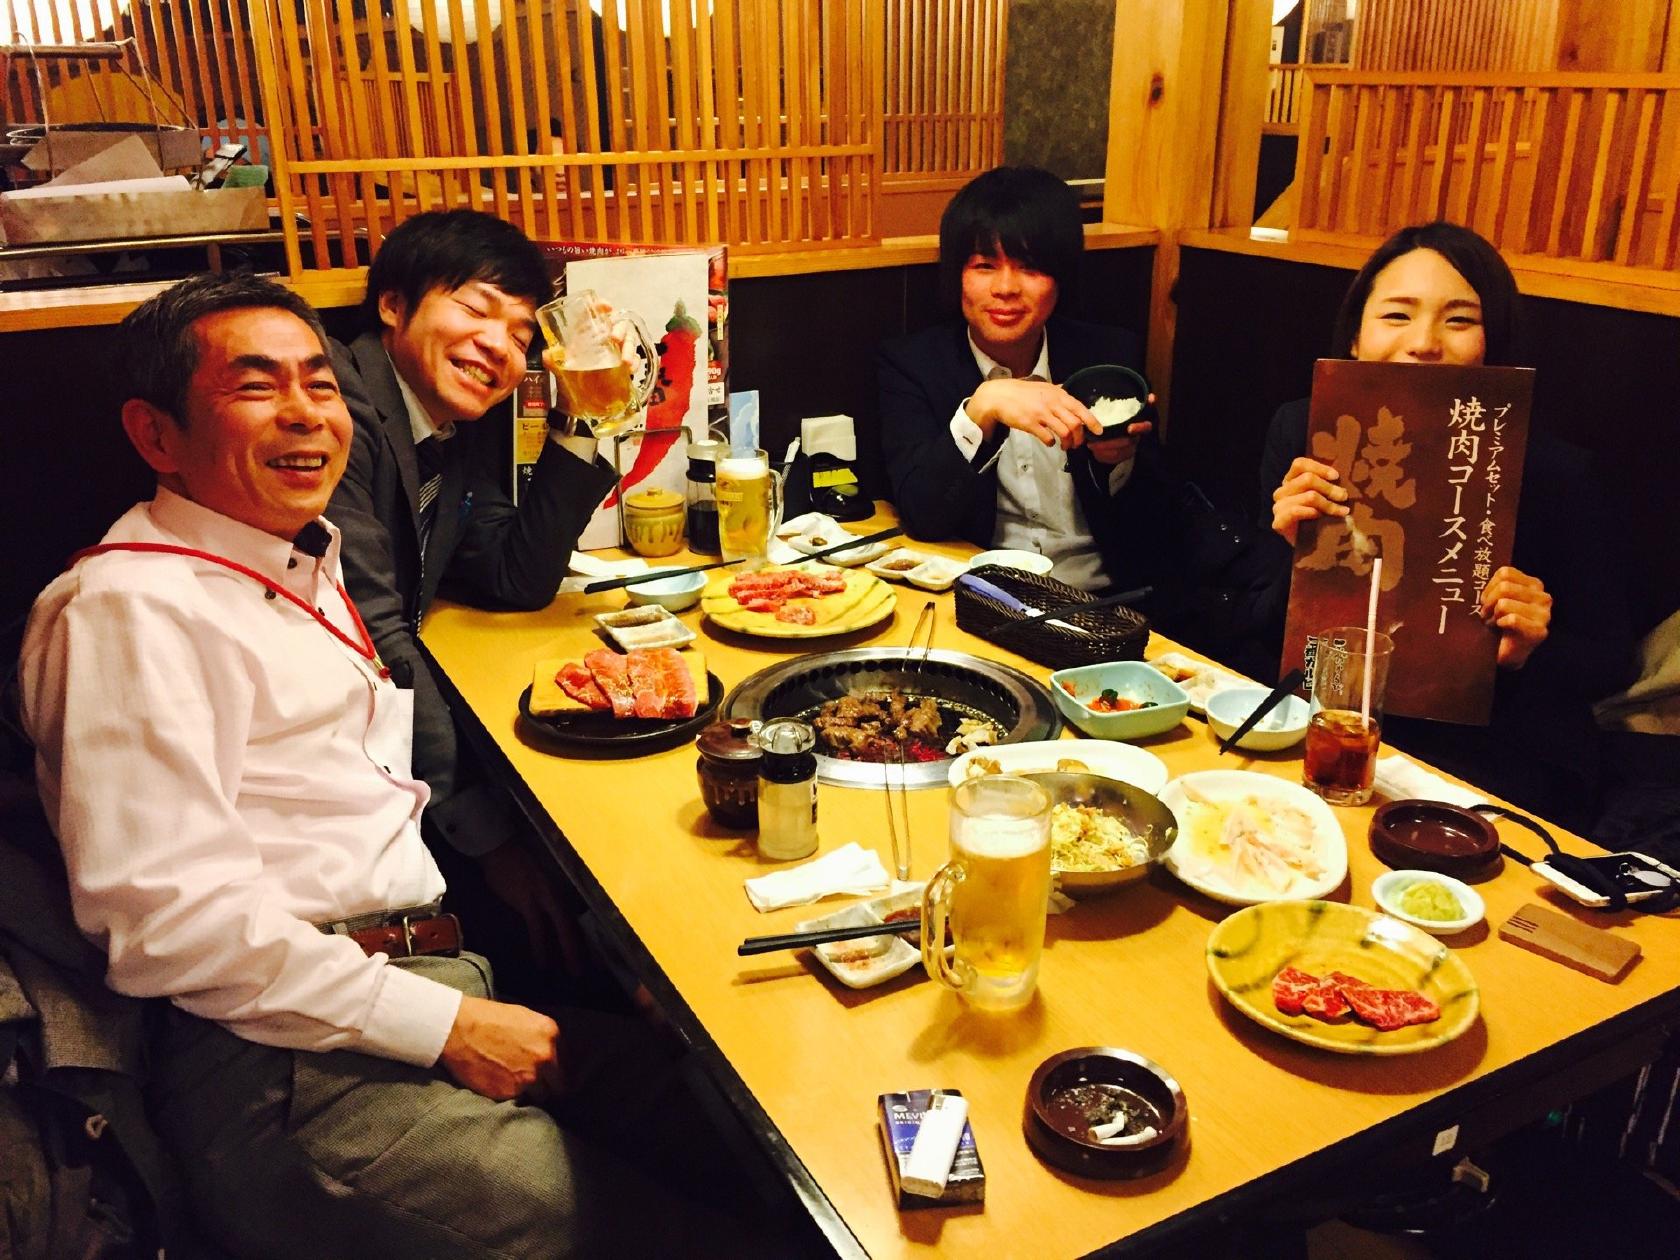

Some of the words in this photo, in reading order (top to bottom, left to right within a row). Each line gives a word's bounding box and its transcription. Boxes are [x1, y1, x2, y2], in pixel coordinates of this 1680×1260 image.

[1296, 405, 1418, 592] 焼肉
[1432, 396, 1487, 634] 焼肉コースメニュー
